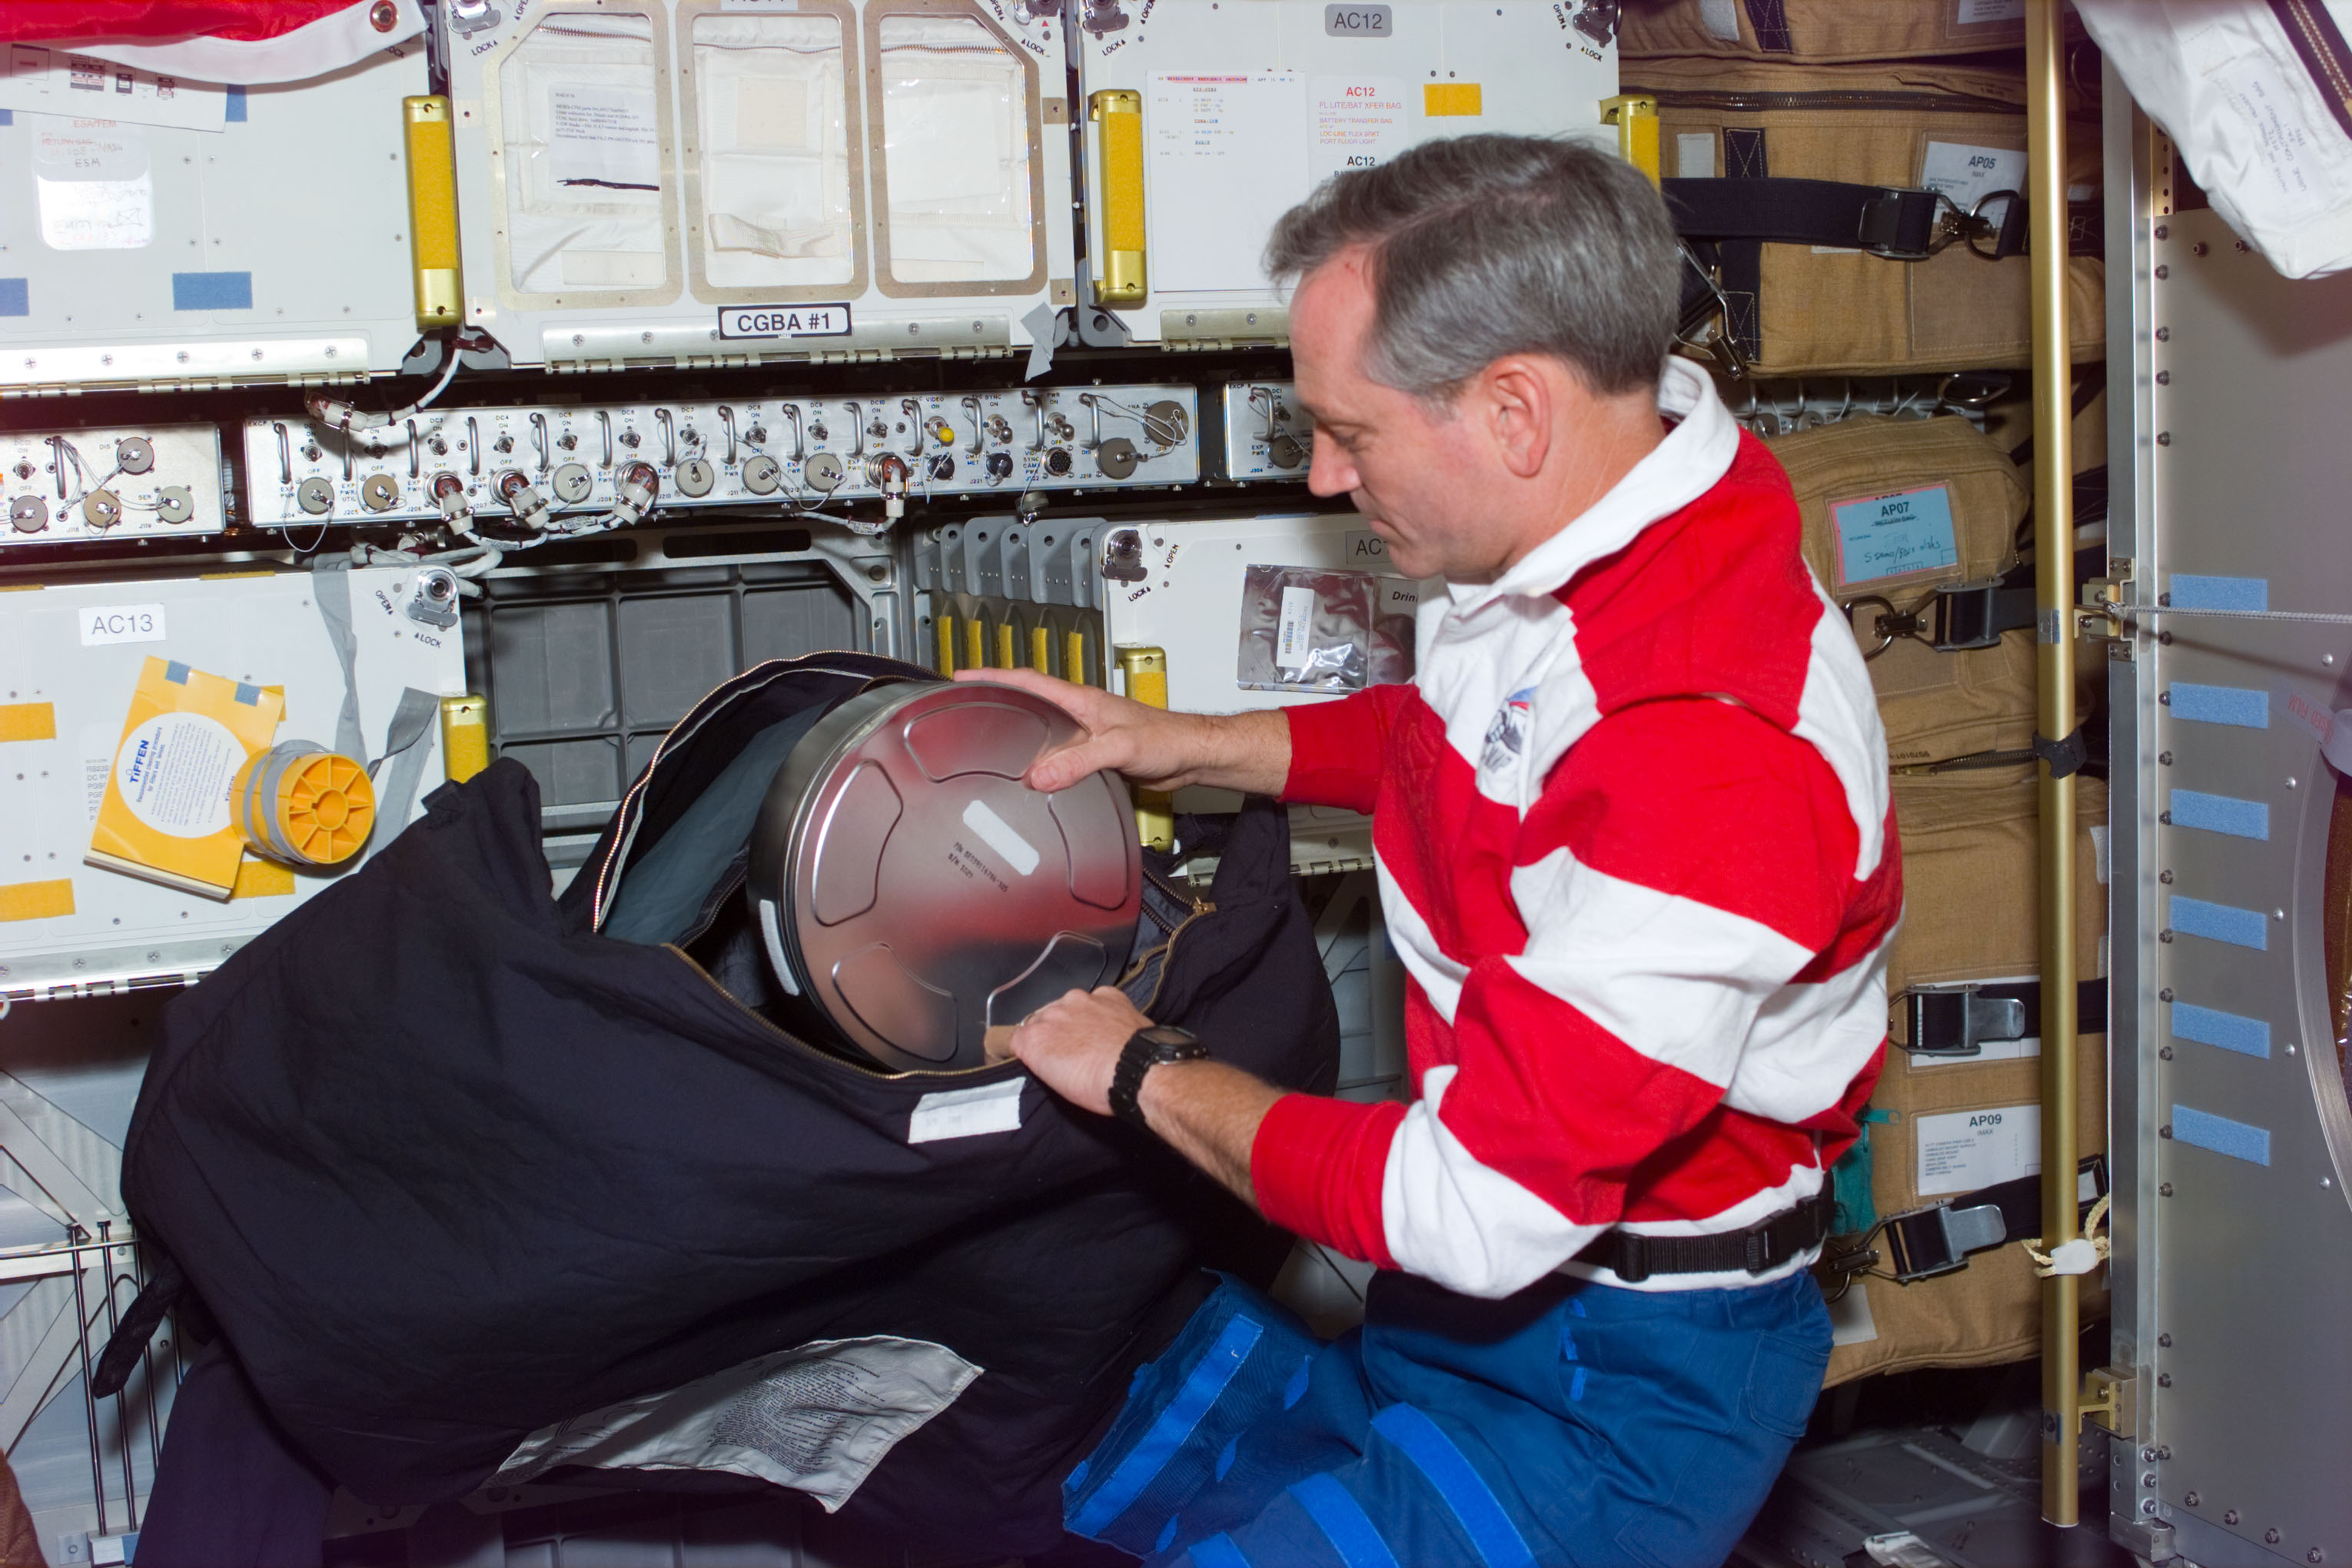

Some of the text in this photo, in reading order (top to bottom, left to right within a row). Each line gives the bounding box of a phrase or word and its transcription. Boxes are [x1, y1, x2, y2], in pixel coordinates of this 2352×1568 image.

[1334, 12, 1383, 29] AC12
[471, 43, 493, 56] LOCK
[1026, 40, 1045, 55] LOCK
[1102, 41, 1121, 56] LOCK
[1585, 48, 1603, 61] LOCK
[1347, 87, 1375, 97] AC12
[1347, 156, 1376, 166] AC12
[1968, 156, 1996, 169] AP05
[738, 313, 830, 332] CGBA #1
[1882, 502, 1909, 517] AP07
[1167, 543, 1179, 563] OPEN
[375, 590, 392, 611] OPEN
[1128, 587, 1147, 602] LOCK
[92, 614, 153, 634] AC13
[420, 634, 441, 648] LOCK
[1969, 1114, 2002, 1127] AP09
